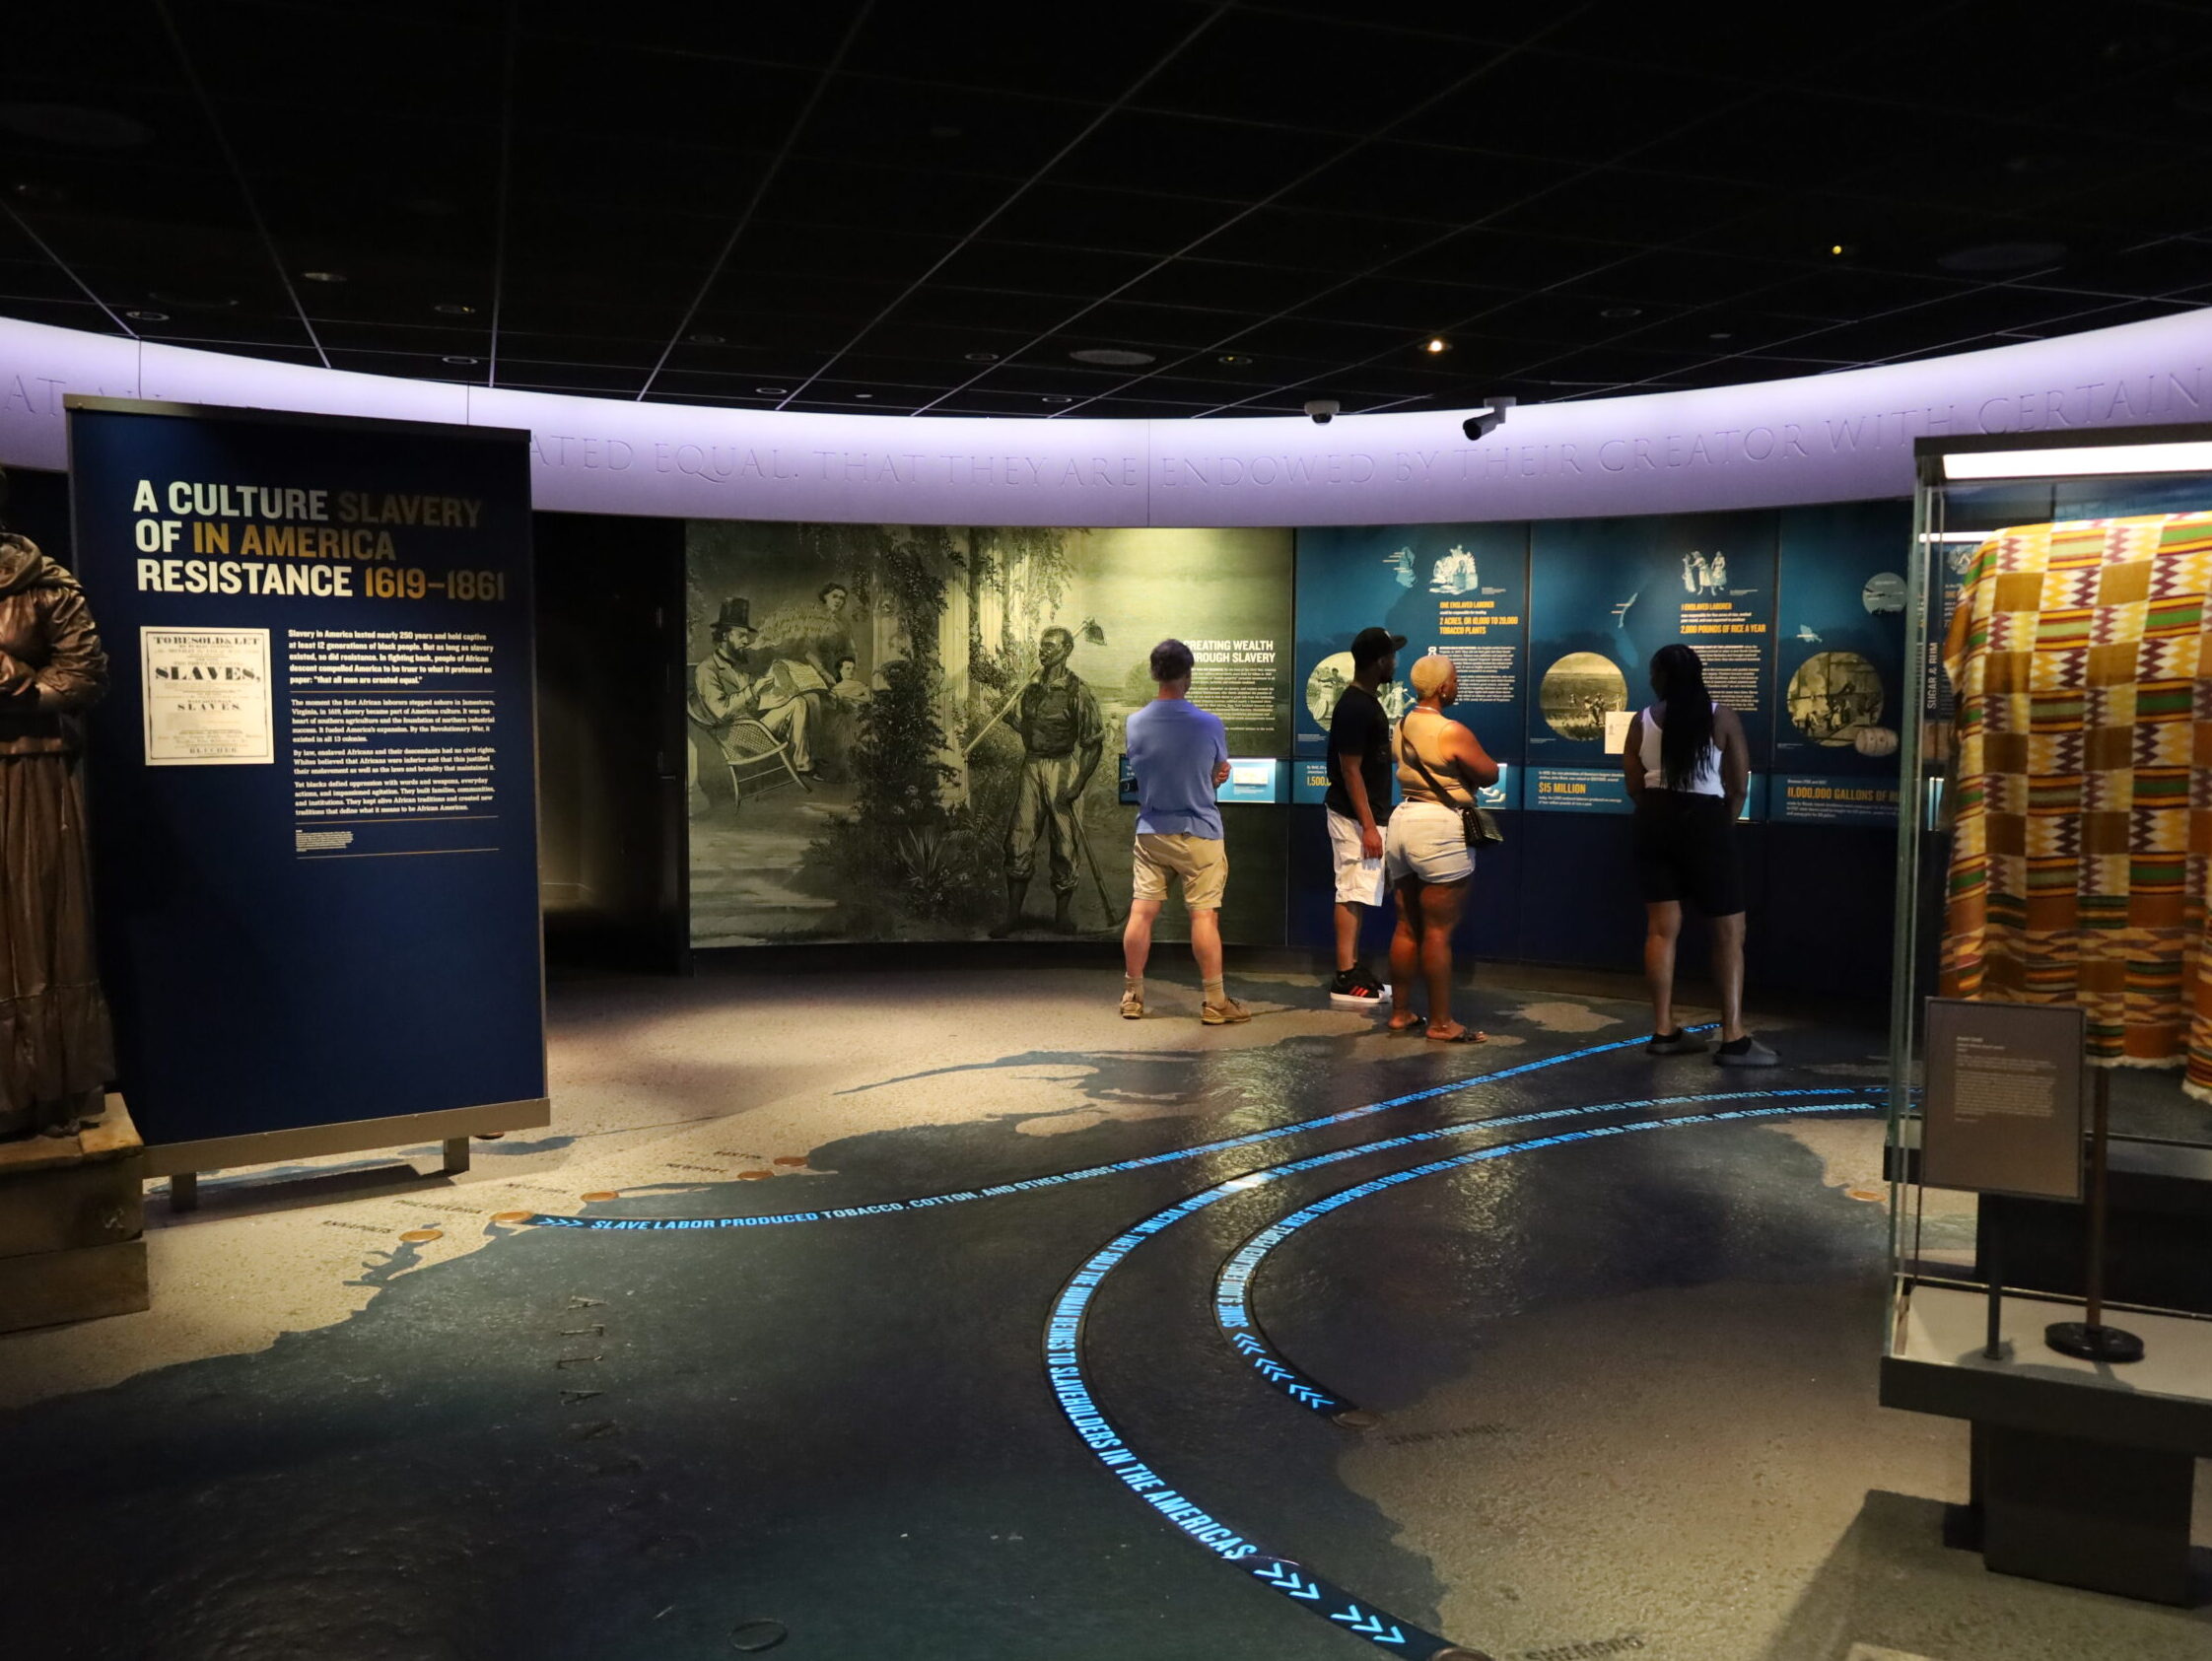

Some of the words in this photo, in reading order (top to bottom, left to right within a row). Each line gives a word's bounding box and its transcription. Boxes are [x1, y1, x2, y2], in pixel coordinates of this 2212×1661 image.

[813, 450, 925, 485] THAT
[940, 454, 1048, 488] THEY
[1058, 456, 1138, 488] ARE
[1161, 452, 1375, 489] ENDOWED
[1395, 450, 1439, 483] BY
[1453, 443, 1586, 482] THEIR
[1598, 423, 1809, 473] CREATOR
[1824, 404, 1955, 452] WITH
[1978, 366, 2203, 435] CERTAIN
[133, 480, 158, 513] A
[168, 481, 329, 520] CULTURE
[338, 491, 482, 529] SLAVERY
[135, 519, 181, 553] OF
[193, 520, 229, 555] IN
[240, 524, 396, 562] AMERICA
[137, 559, 353, 598] RESISTANCE
[288, 630, 314, 640] Slavery
[376, 632, 397, 642] nearly
[1439, 626, 1465, 635] TOBACCO
[1465, 626, 1486, 635] PLANTS
[325, 643, 367, 653] generations
[396, 644, 422, 654] people.
[445, 645, 459, 654] long
[470, 645, 493, 655] slavery
[1233, 640, 1275, 651] WEALTH
[289, 654, 316, 663] existed,
[387, 655, 414, 664] fighting
[414, 656, 433, 664] back,
[434, 656, 455, 664] people
[1194, 652, 1230, 662] ROUGH
[1232, 652, 1277, 662] SLAVERY
[156, 666, 261, 682] SLAVES,
[317, 665, 353, 674] compelled
[450, 666, 482, 675] professed
[1927, 677, 1937, 710] SUGAR
[1539, 782, 1553, 794] $15
[1554, 783, 1586, 795] MILLION
[1834, 789, 1874, 800] GALLONS
[1876, 791, 1887, 801] OF
[1411, 1156, 1461, 1176] AFRICA
[1377, 1171, 1420, 1185] FROM
[591, 1219, 646, 1230] SLAVE
[654, 1218, 715, 1230] LABOR
[721, 1211, 819, 1228] PRODUCED
[821, 1202, 910, 1220] TOBACCO,
[909, 1191, 984, 1209] COTTON,
[982, 1185, 1017, 1198] AND
[1014, 1175, 1069, 1191] OTHER
[1065, 1166, 1117, 1181] GOODS
[1305, 1181, 1389, 1213] TRANSPORTED
[1279, 1211, 1320, 1228] WERE
[1106, 1234, 1146, 1253] THEY
[1249, 1224, 1295, 1249] PEOPLE
[1085, 1251, 1124, 1271] SOLD
[1222, 1246, 1268, 1282] ENSLAVED
[1071, 1271, 1106, 1286] THE
[1055, 1286, 1094, 1316] HUMAN
[1217, 1304, 1250, 1328] SOME
[1047, 1317, 1079, 1350] BEINGS
[1048, 1351, 1077, 1365] TO
[1049, 1366, 1123, 1449] SLAVEHOLDERS
[1098, 1448, 1137, 1466] IN
[1115, 1463, 1165, 1491] THE
[1143, 1490, 1258, 1560] AMERICAS
